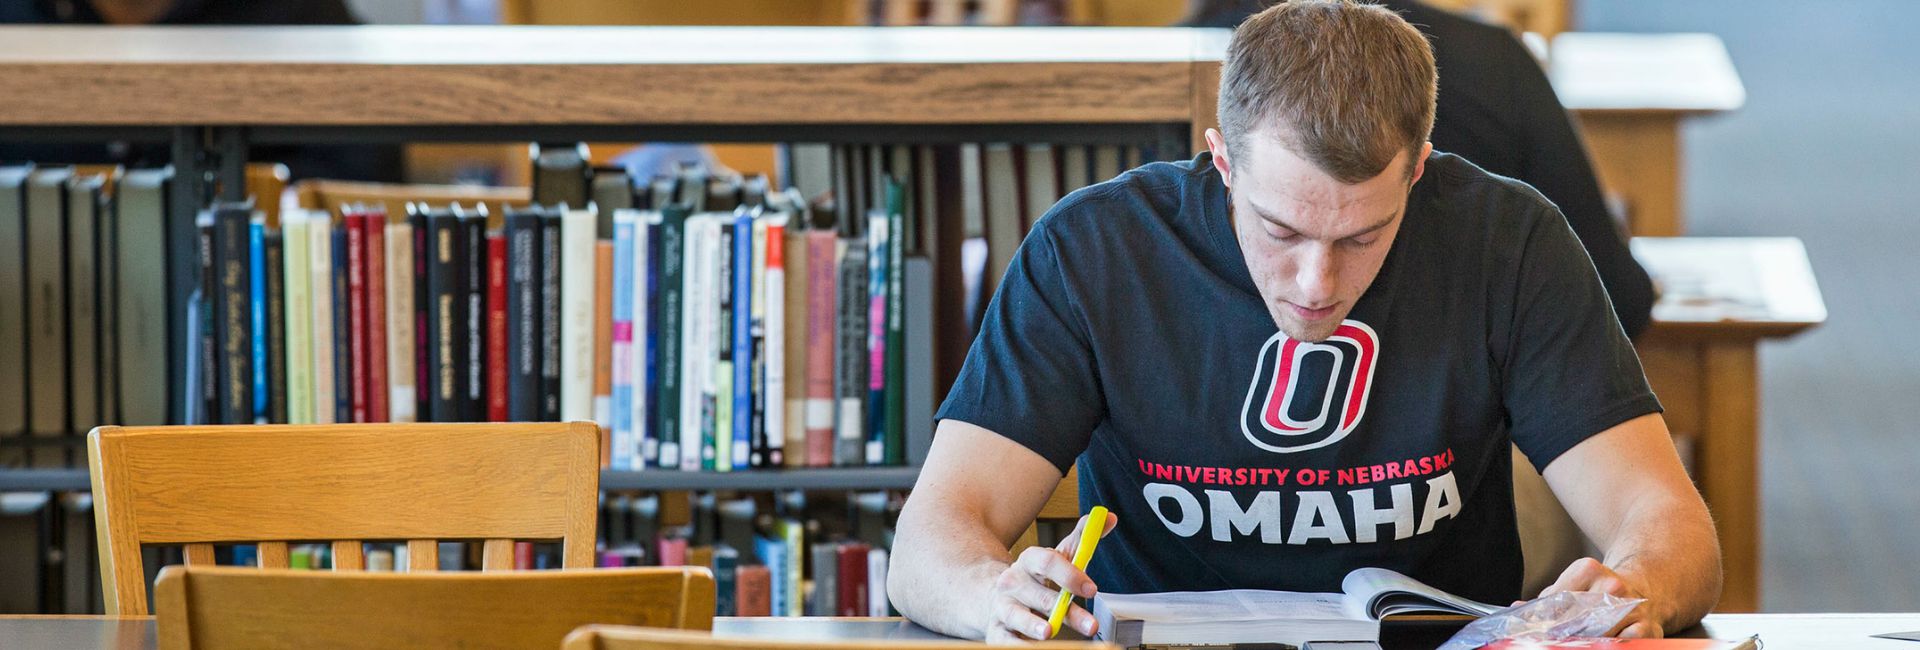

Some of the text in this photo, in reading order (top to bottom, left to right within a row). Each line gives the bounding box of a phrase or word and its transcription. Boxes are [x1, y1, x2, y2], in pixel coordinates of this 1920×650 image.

[1138, 458, 1290, 486] UNIVERSITY
[1296, 468, 1331, 486] OF
[1143, 470, 1463, 545] OMAHA
